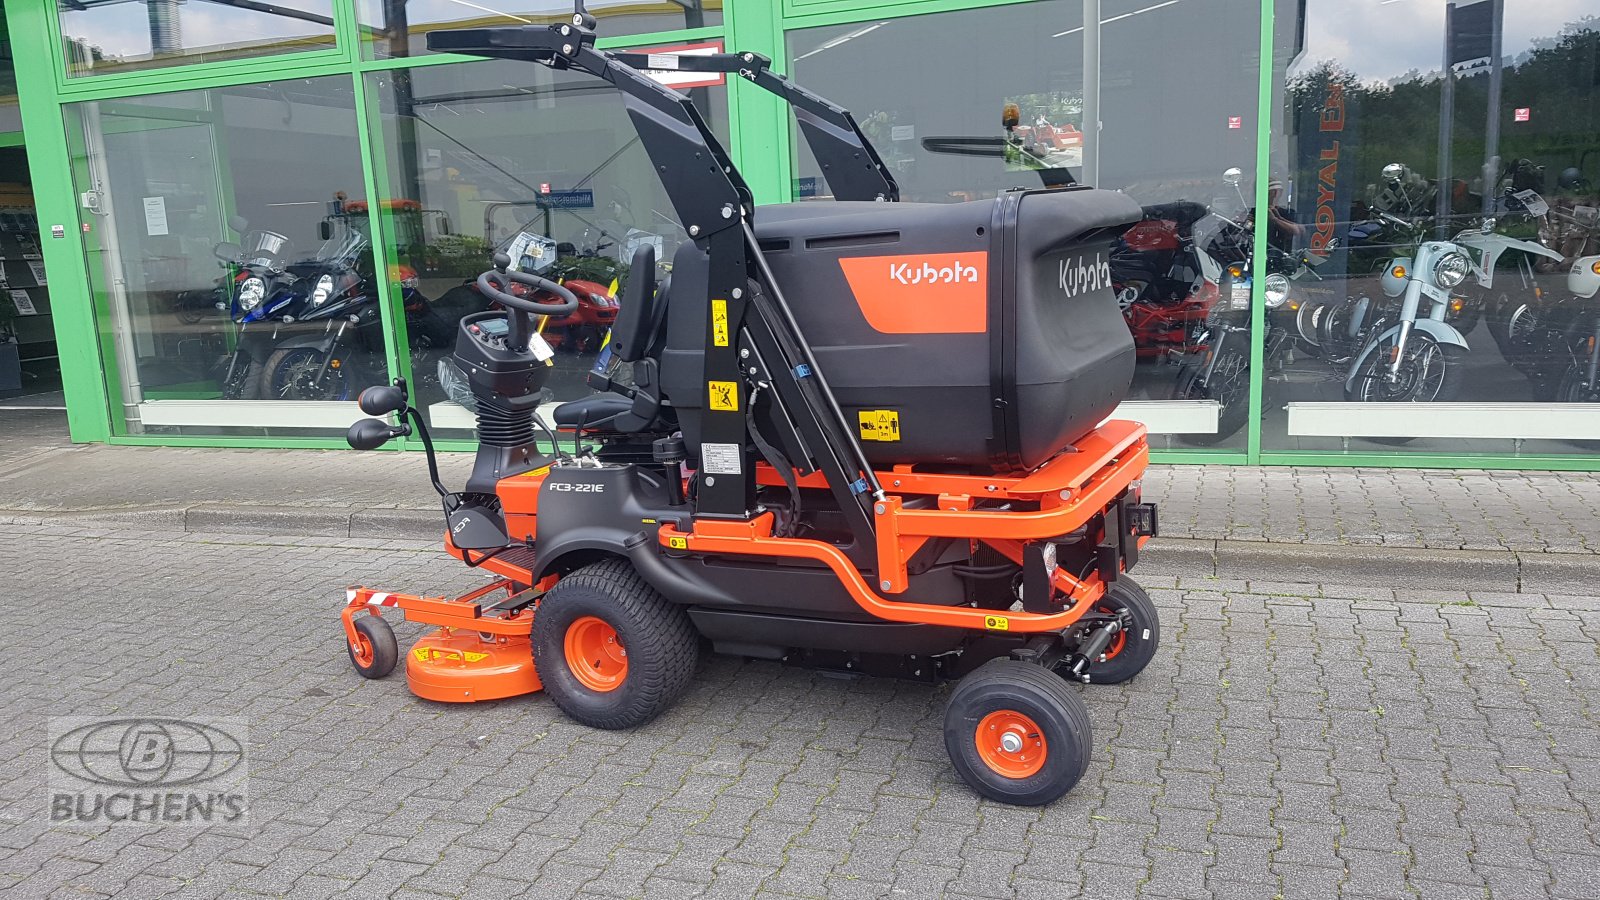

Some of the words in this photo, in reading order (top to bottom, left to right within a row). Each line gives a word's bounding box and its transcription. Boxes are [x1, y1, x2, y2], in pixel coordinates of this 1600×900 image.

[1310, 140, 1340, 258] ROYAL
[890, 260, 978, 285] Kubota
[1059, 252, 1112, 298] Kubota
[549, 482, 605, 493] FC3-221E
